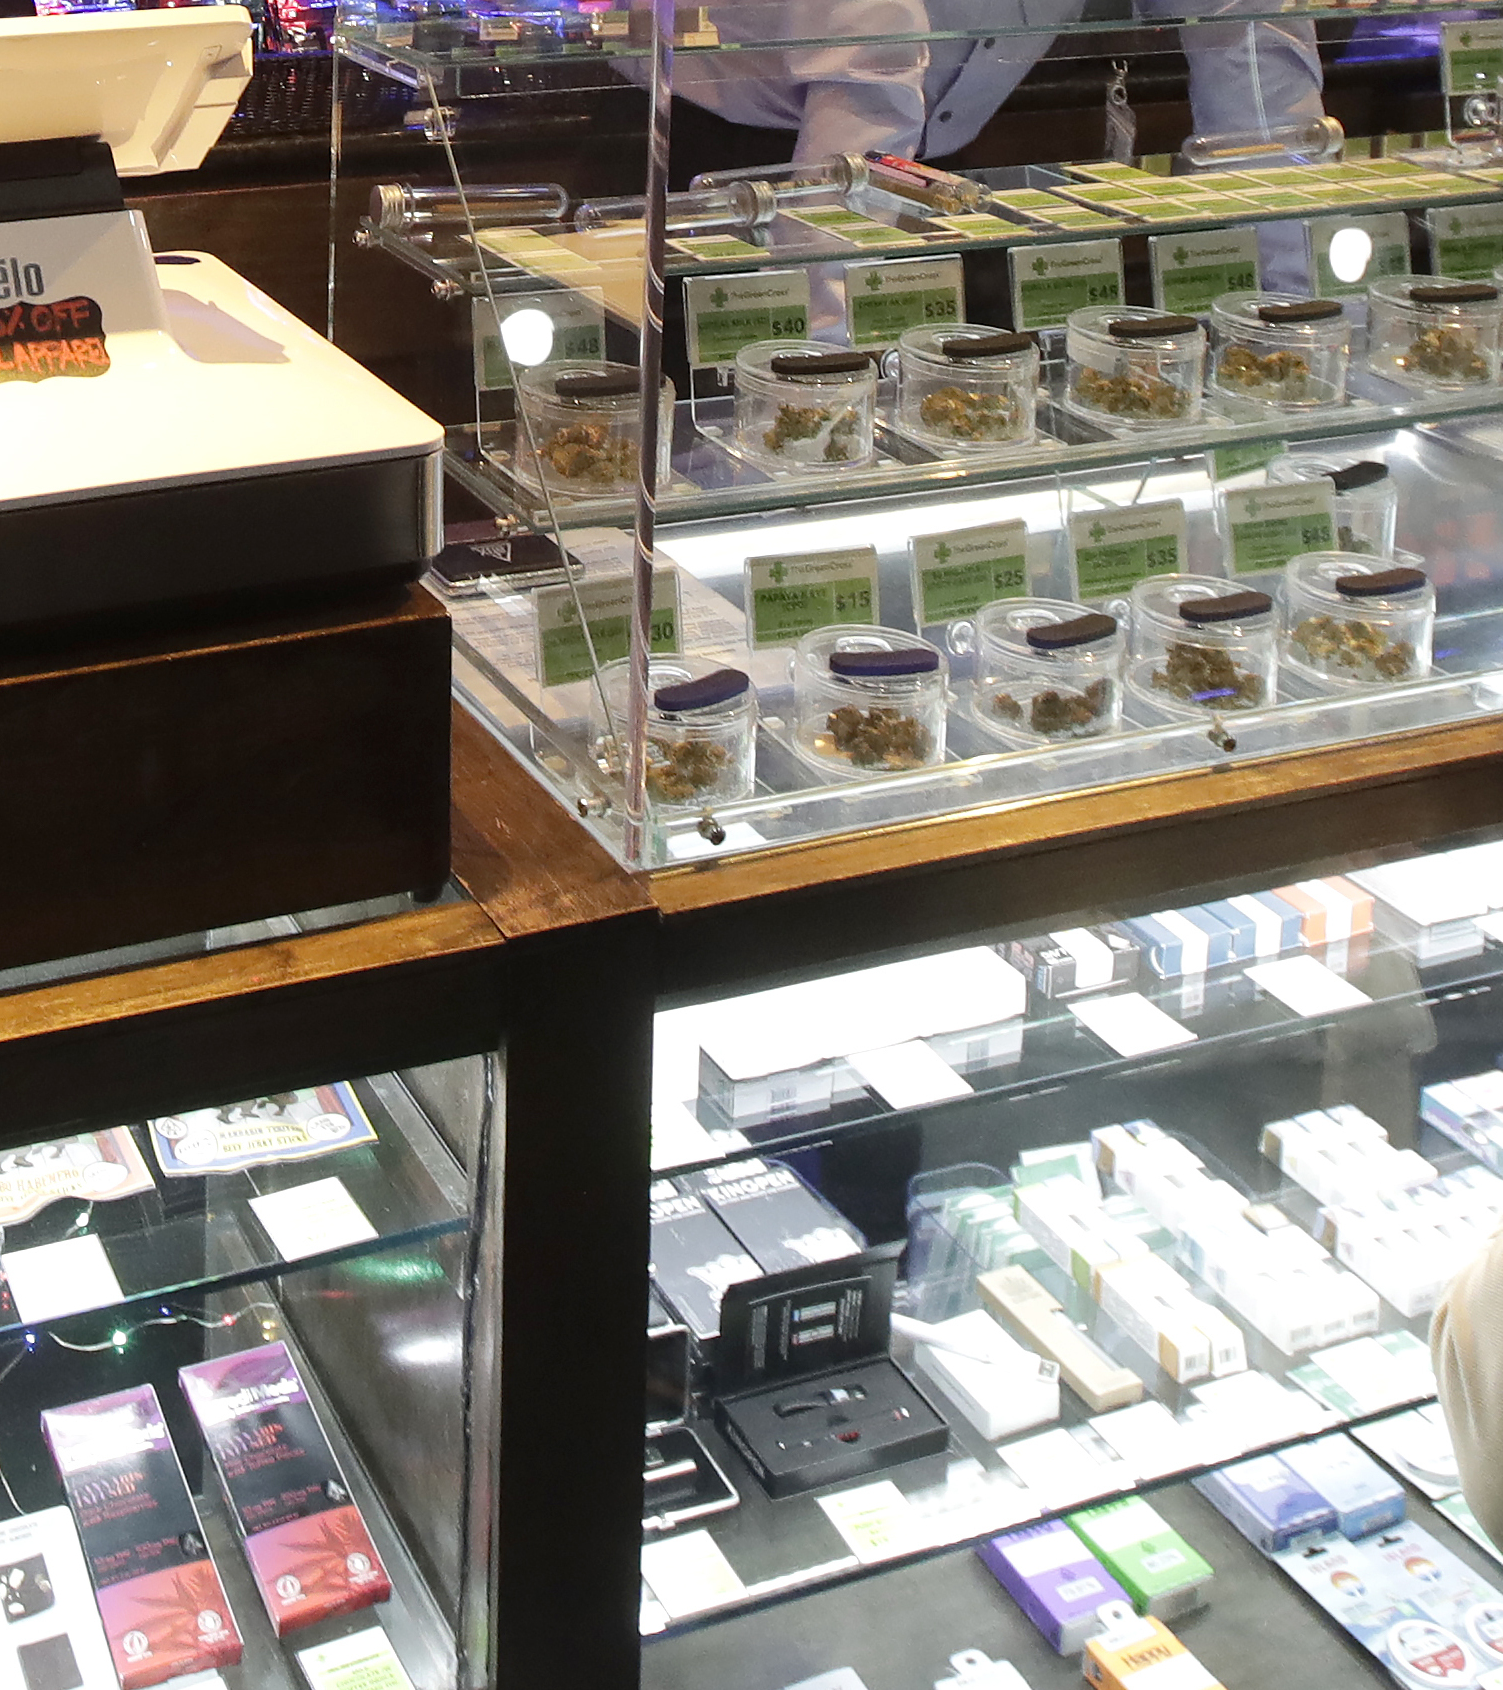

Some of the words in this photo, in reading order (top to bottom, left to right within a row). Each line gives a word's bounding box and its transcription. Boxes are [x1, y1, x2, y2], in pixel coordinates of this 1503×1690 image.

[31, 300, 90, 333] OFF
[925, 301, 956, 318] $35
[772, 318, 805, 335] $40
[994, 570, 1023, 589] $25
[836, 591, 869, 612] $15
